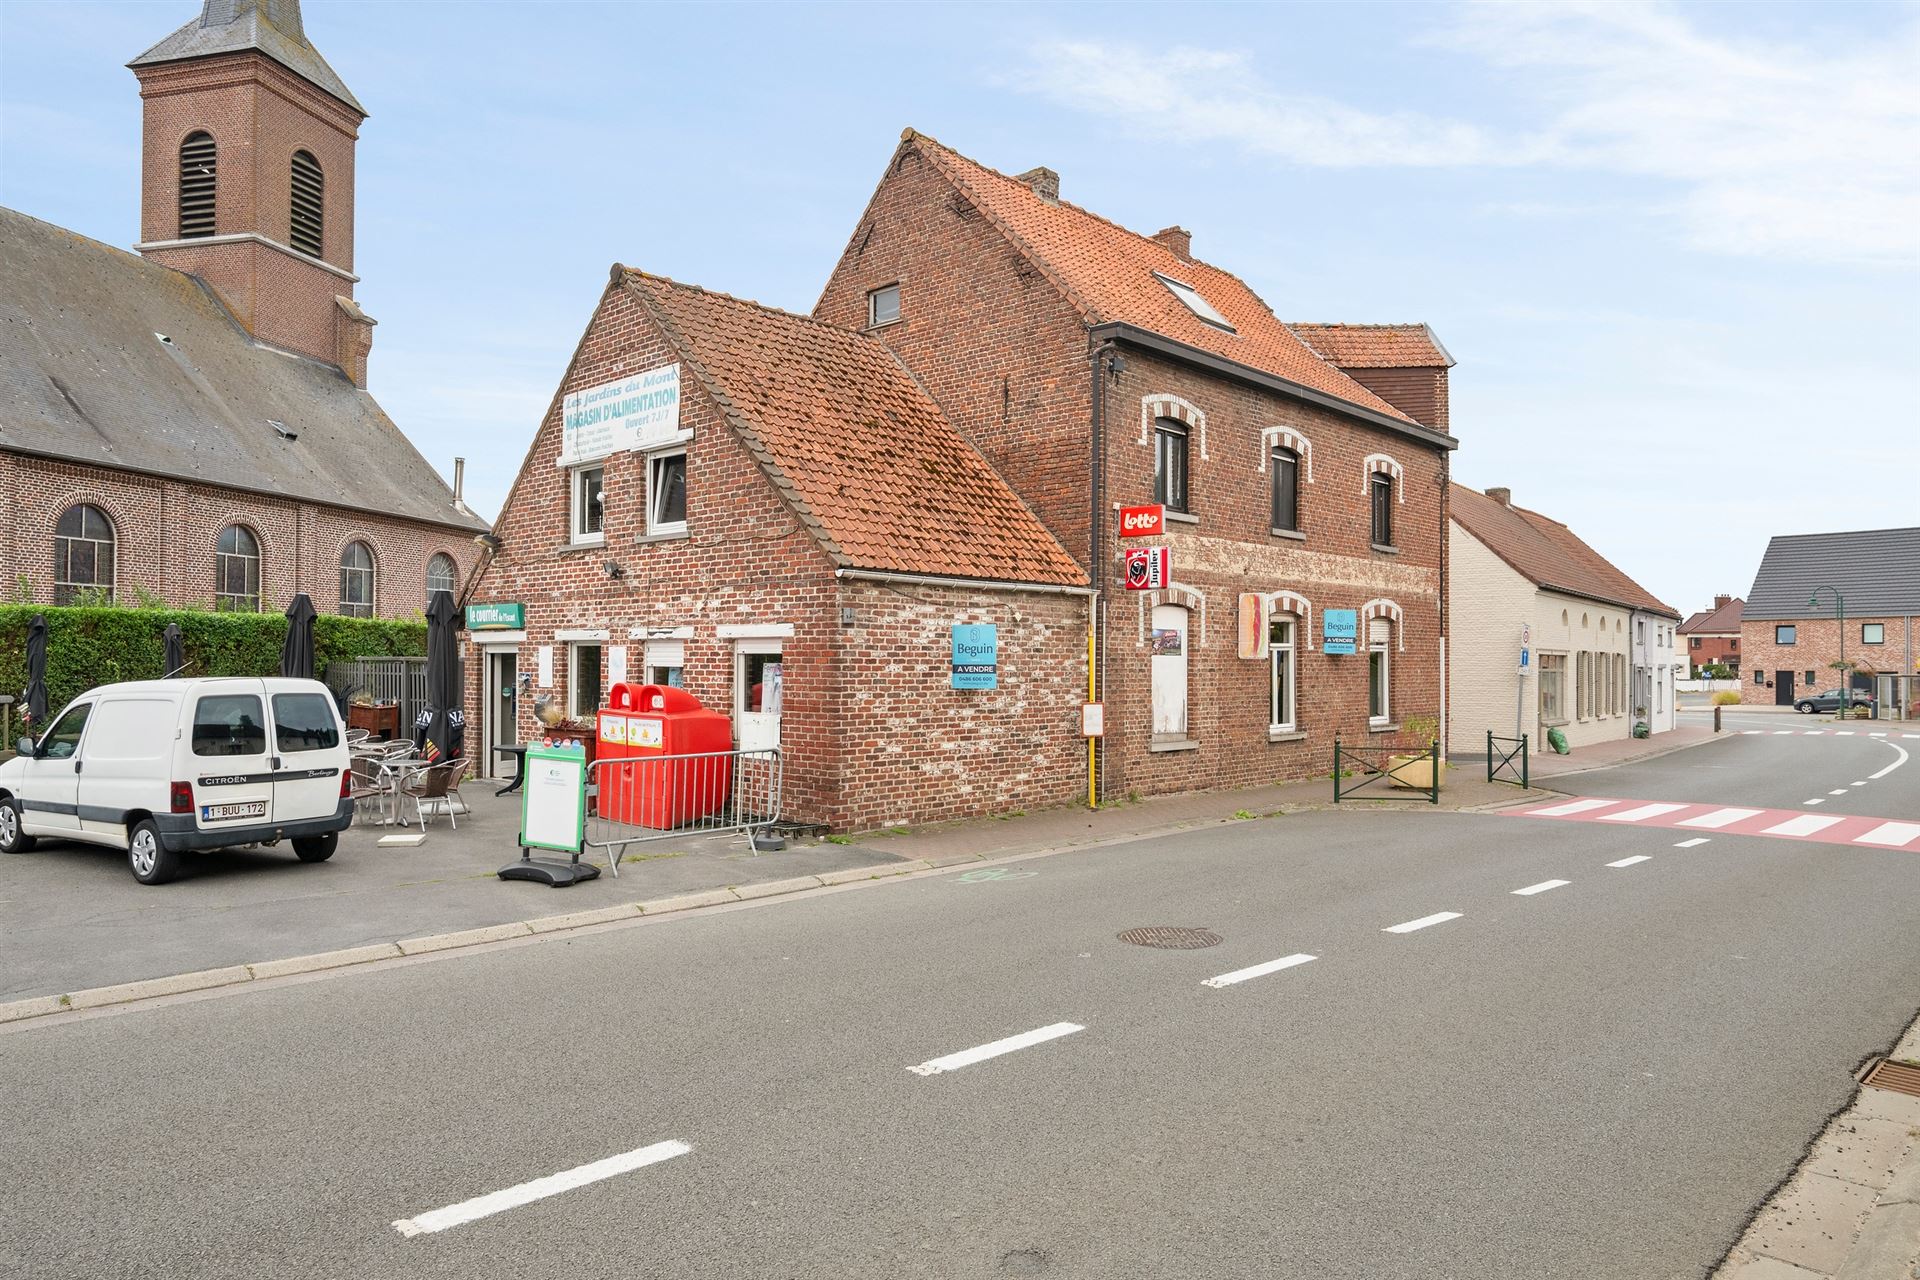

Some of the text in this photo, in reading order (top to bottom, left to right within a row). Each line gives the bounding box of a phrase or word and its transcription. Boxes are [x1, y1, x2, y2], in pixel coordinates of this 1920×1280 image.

[566, 370, 676, 409] Les Jardins du Mont
[566, 387, 676, 430] MAGASIN D'ALIMENTATION
[625, 414, 649, 429] Ouvert
[1151, 550, 1159, 585] Jupiler
[470, 605, 476, 622] le
[476, 605, 499, 622] courrier
[1327, 622, 1354, 632] Beguin
[957, 643, 993, 657] Beguin
[205, 776, 247, 785] CITROËN
[307, 769, 334, 777] Berlingo
